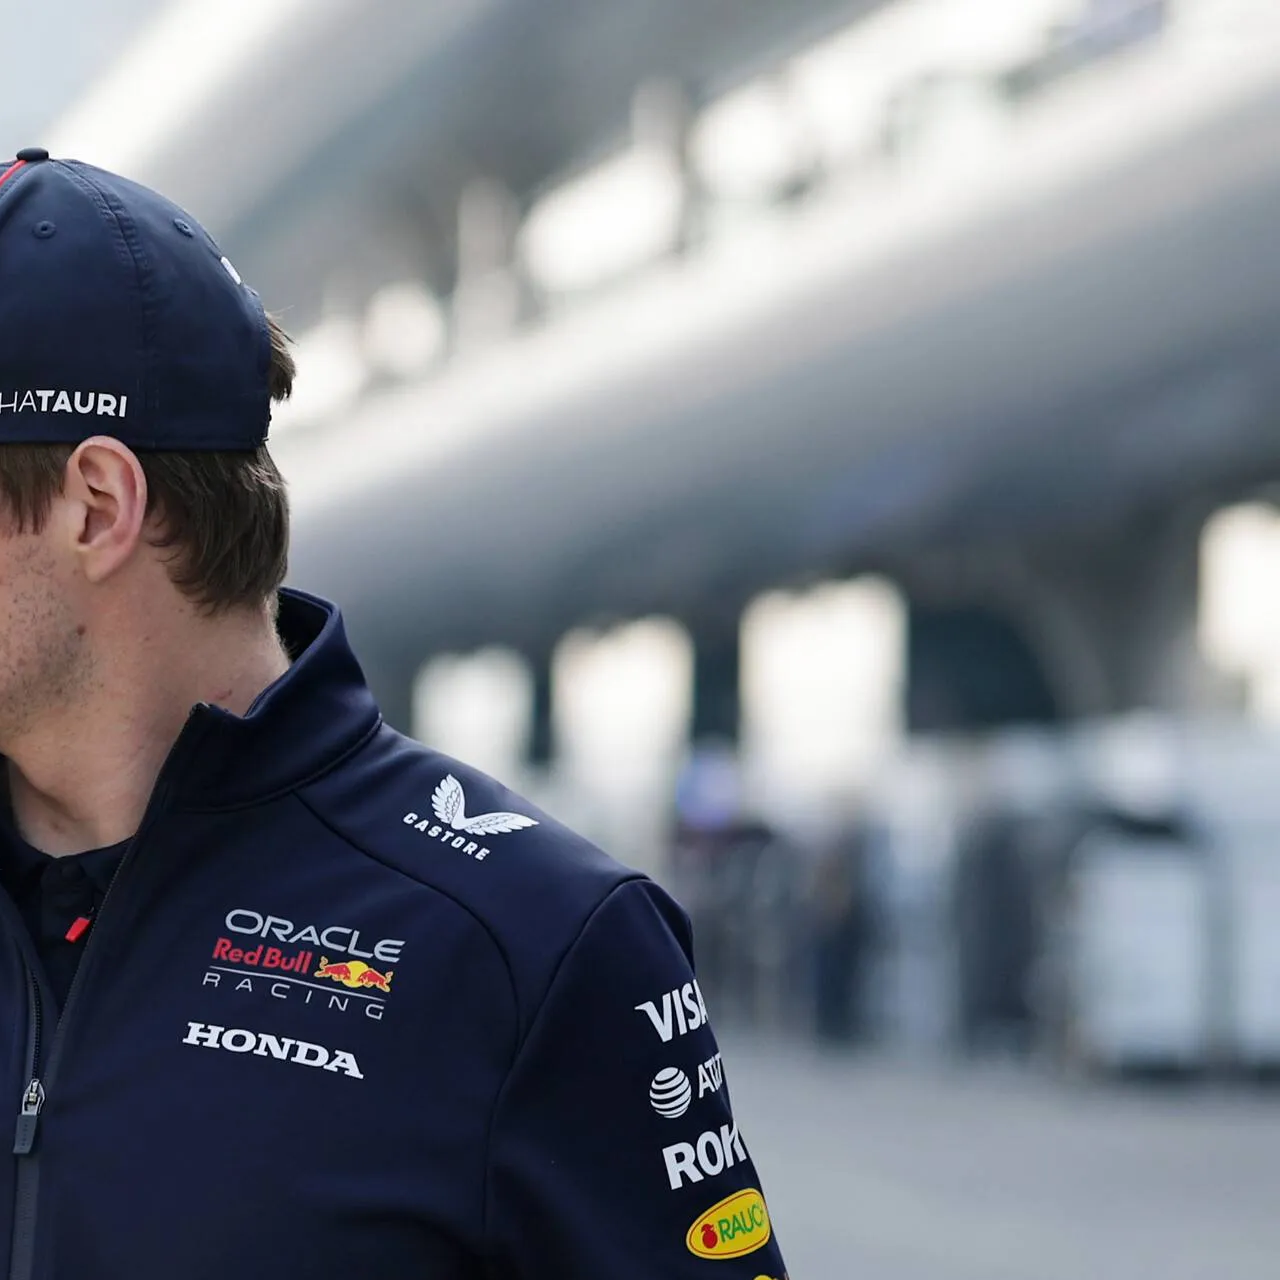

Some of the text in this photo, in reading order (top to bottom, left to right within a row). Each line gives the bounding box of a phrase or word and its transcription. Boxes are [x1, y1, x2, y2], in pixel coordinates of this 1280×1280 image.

[403, 812, 490, 861] CASTORE
[212, 937, 313, 975] Red Bull
[225, 908, 407, 963] ORACLE
[202, 972, 385, 1020] RACING
[182, 1022, 364, 1080] HONDA
